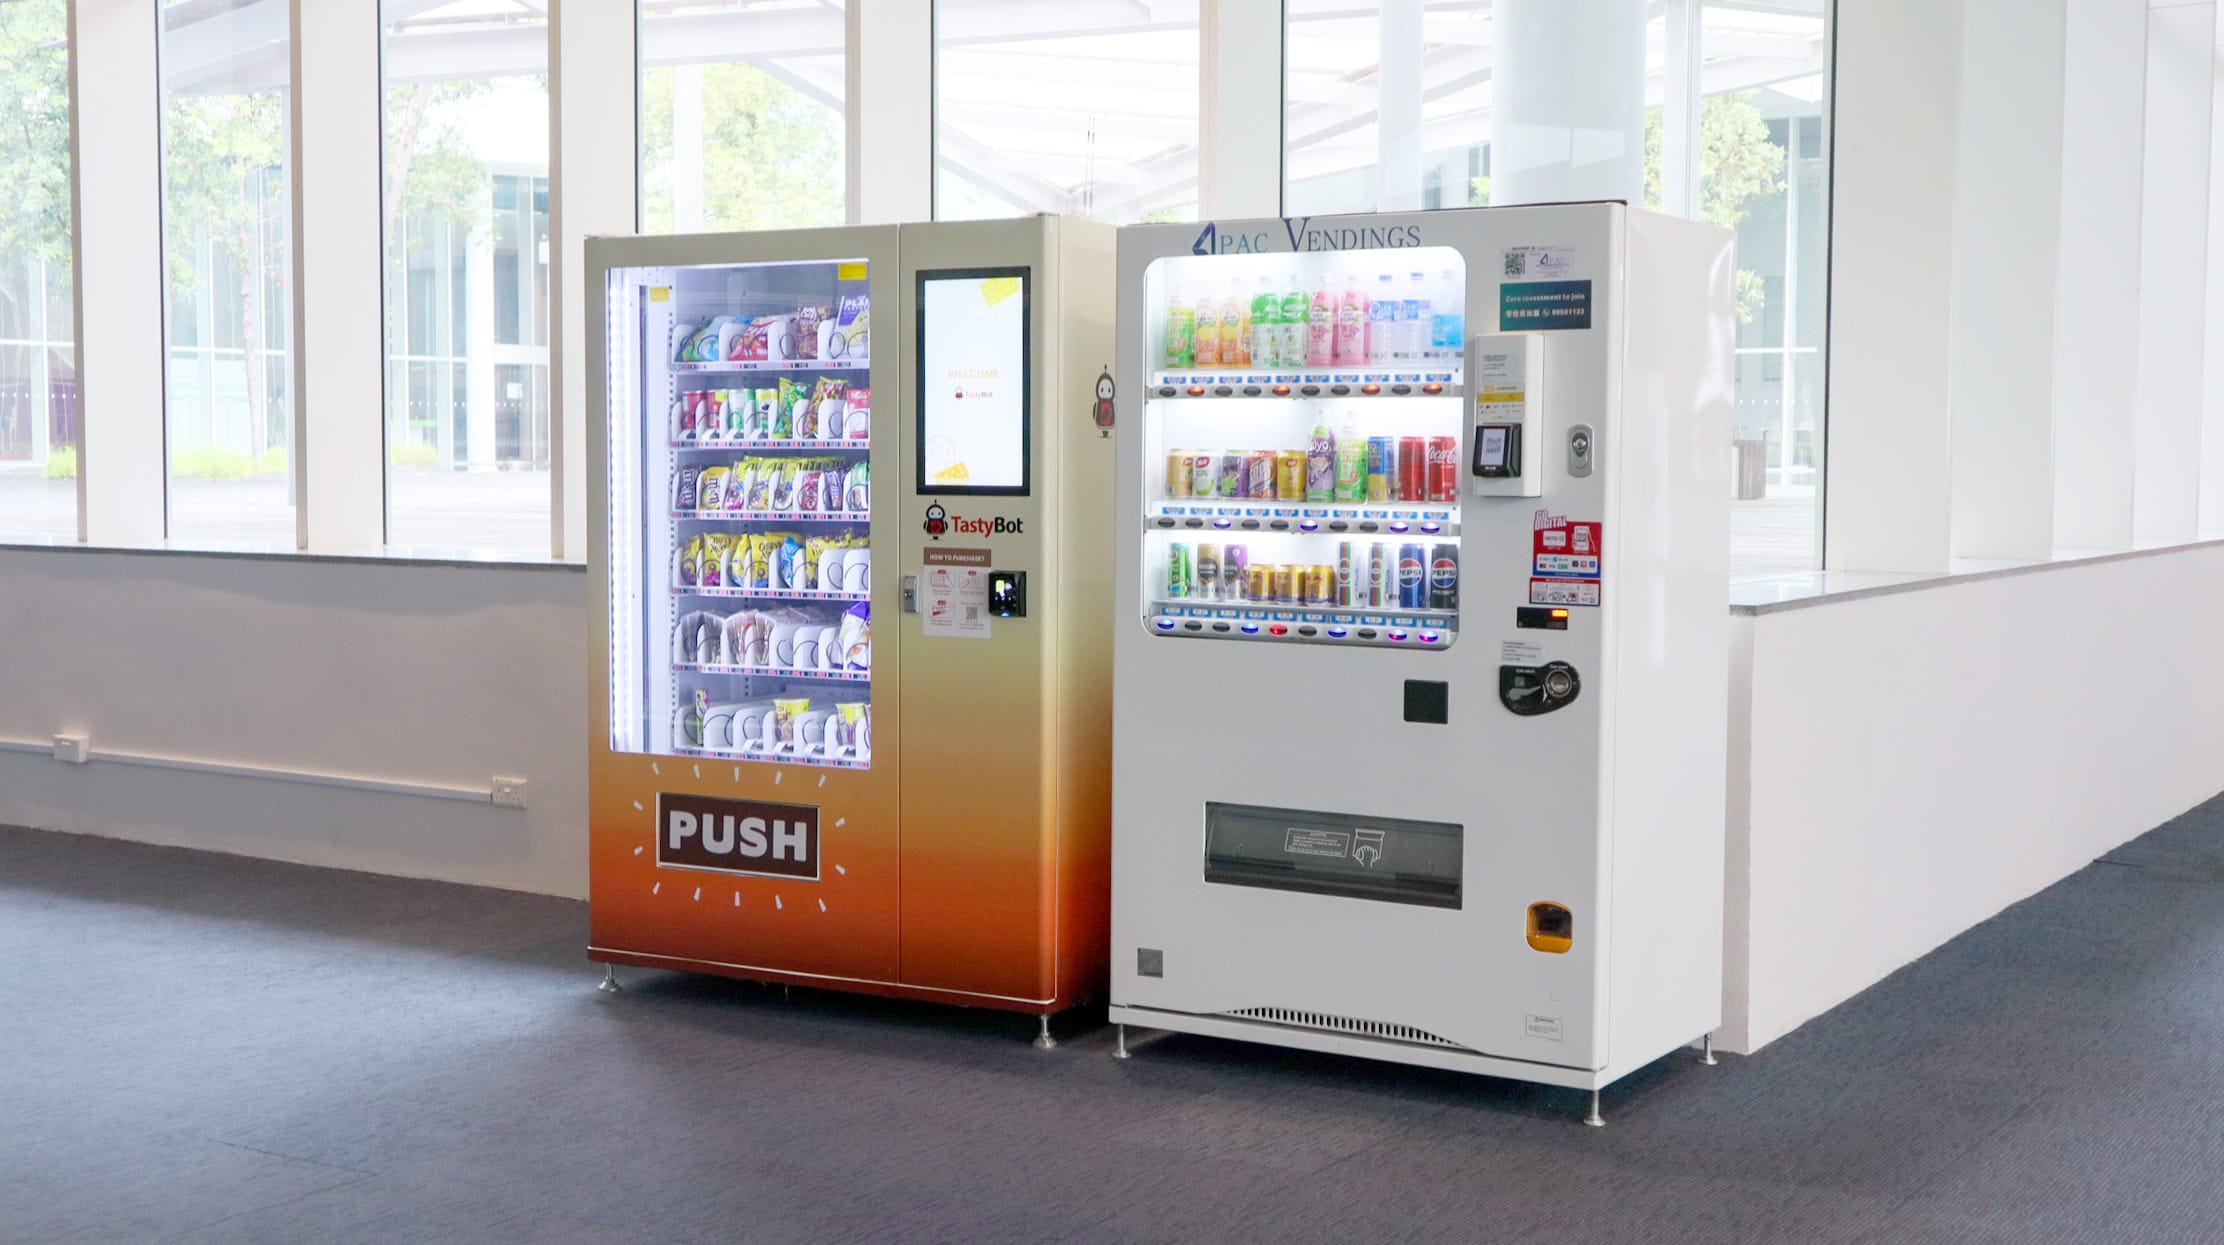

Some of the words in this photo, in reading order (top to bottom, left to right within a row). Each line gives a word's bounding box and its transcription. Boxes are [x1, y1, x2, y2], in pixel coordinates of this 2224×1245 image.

[1281, 216, 1421, 252] VENDINGS
[1571, 291, 1585, 301] join
[948, 368, 999, 379] WELCOME
[951, 516, 1024, 539] TastyBot
[1535, 516, 1567, 531] DIGITAL
[669, 810, 807, 862] PUSH
